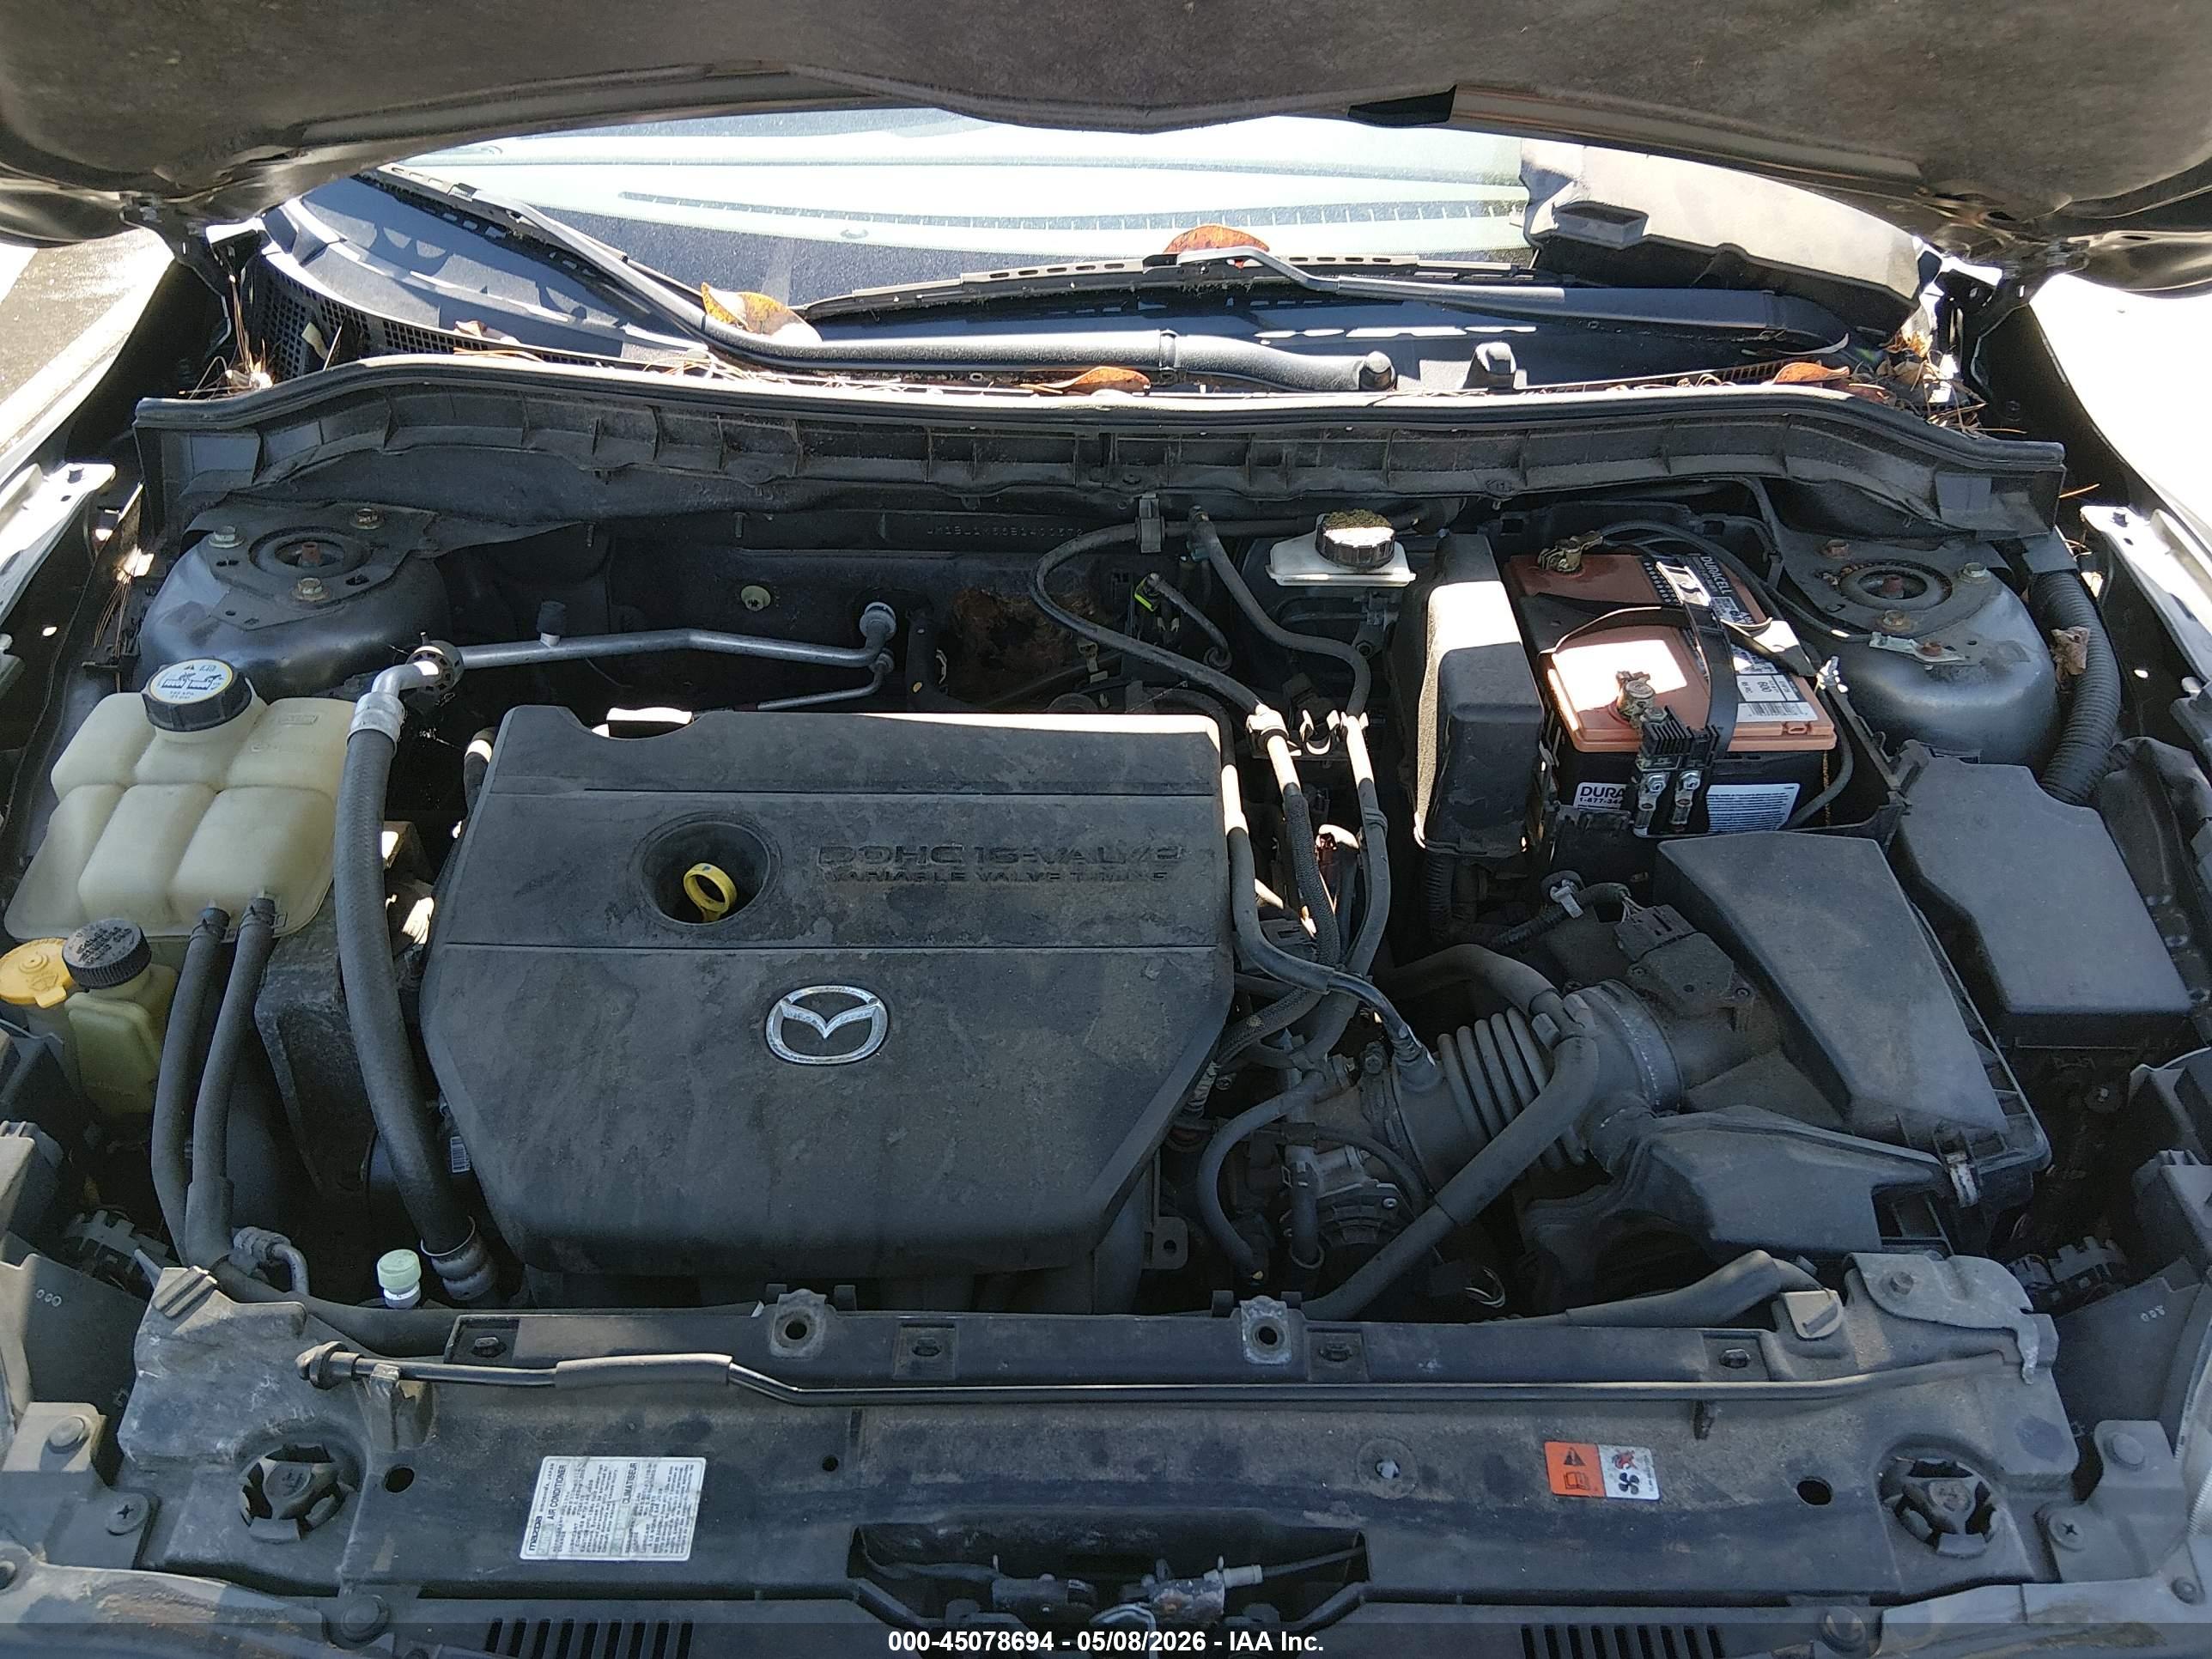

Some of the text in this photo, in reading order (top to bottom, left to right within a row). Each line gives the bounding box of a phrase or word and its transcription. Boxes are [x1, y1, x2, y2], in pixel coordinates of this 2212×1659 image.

[1700, 556, 1733, 594] DURACELL
[818, 845, 965, 866] DOHC
[831, 870, 966, 883] VARIABLE
[975, 871, 1060, 884] VALVE
[550, 1465, 567, 1507] CONDITIONER
[622, 1464, 638, 1504] CLIMATISEUR
[546, 1510, 556, 1520] AIR
[528, 1516, 543, 1551] mazda
